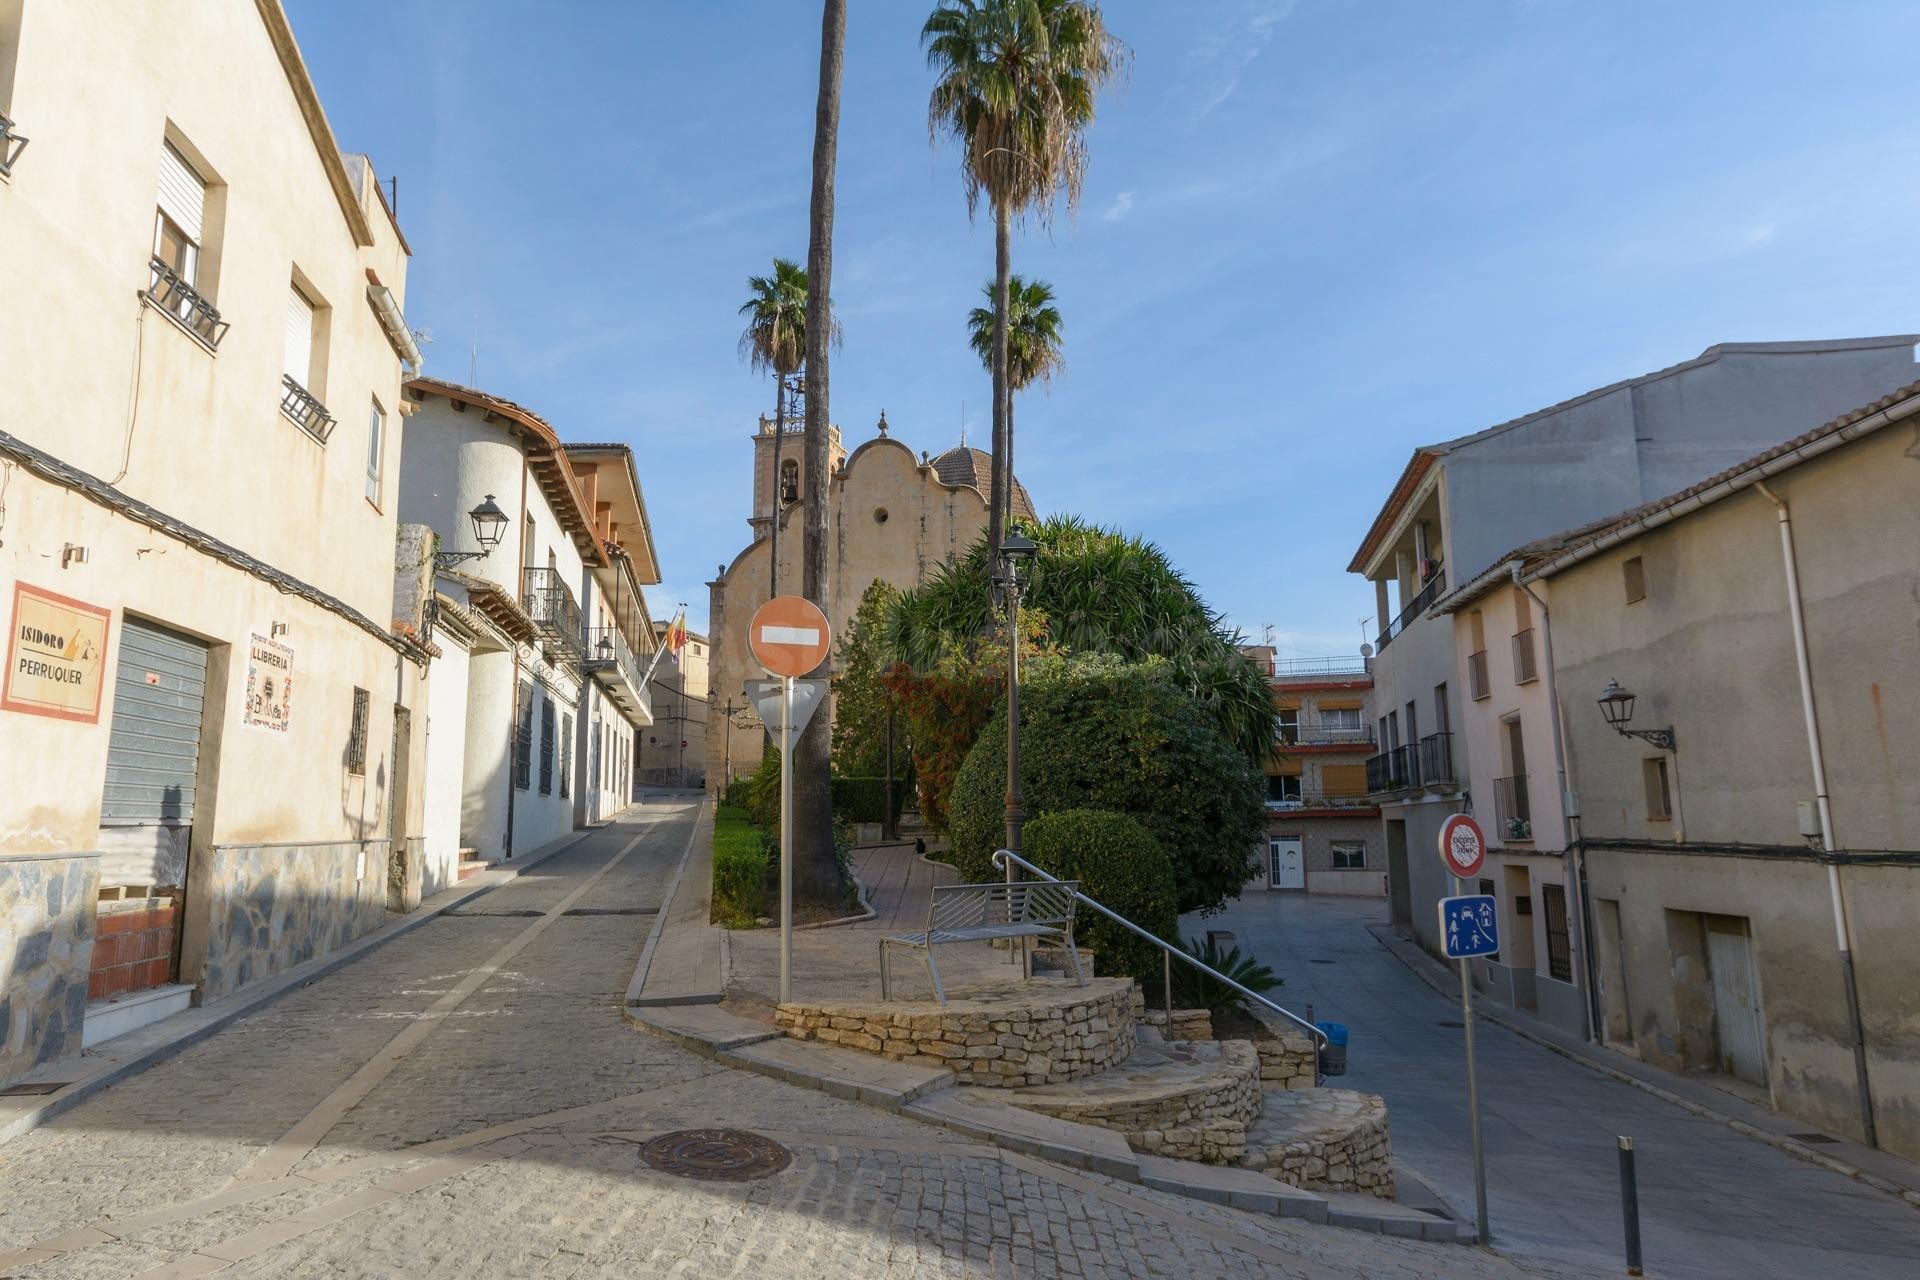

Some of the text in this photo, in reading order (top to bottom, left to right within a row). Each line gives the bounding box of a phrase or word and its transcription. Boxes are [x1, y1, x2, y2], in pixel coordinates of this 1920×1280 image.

[21, 625, 64, 650] ISIDORO
[252, 646, 288, 671] LLIBRERIA
[20, 658, 82, 685] PERRUQUER
